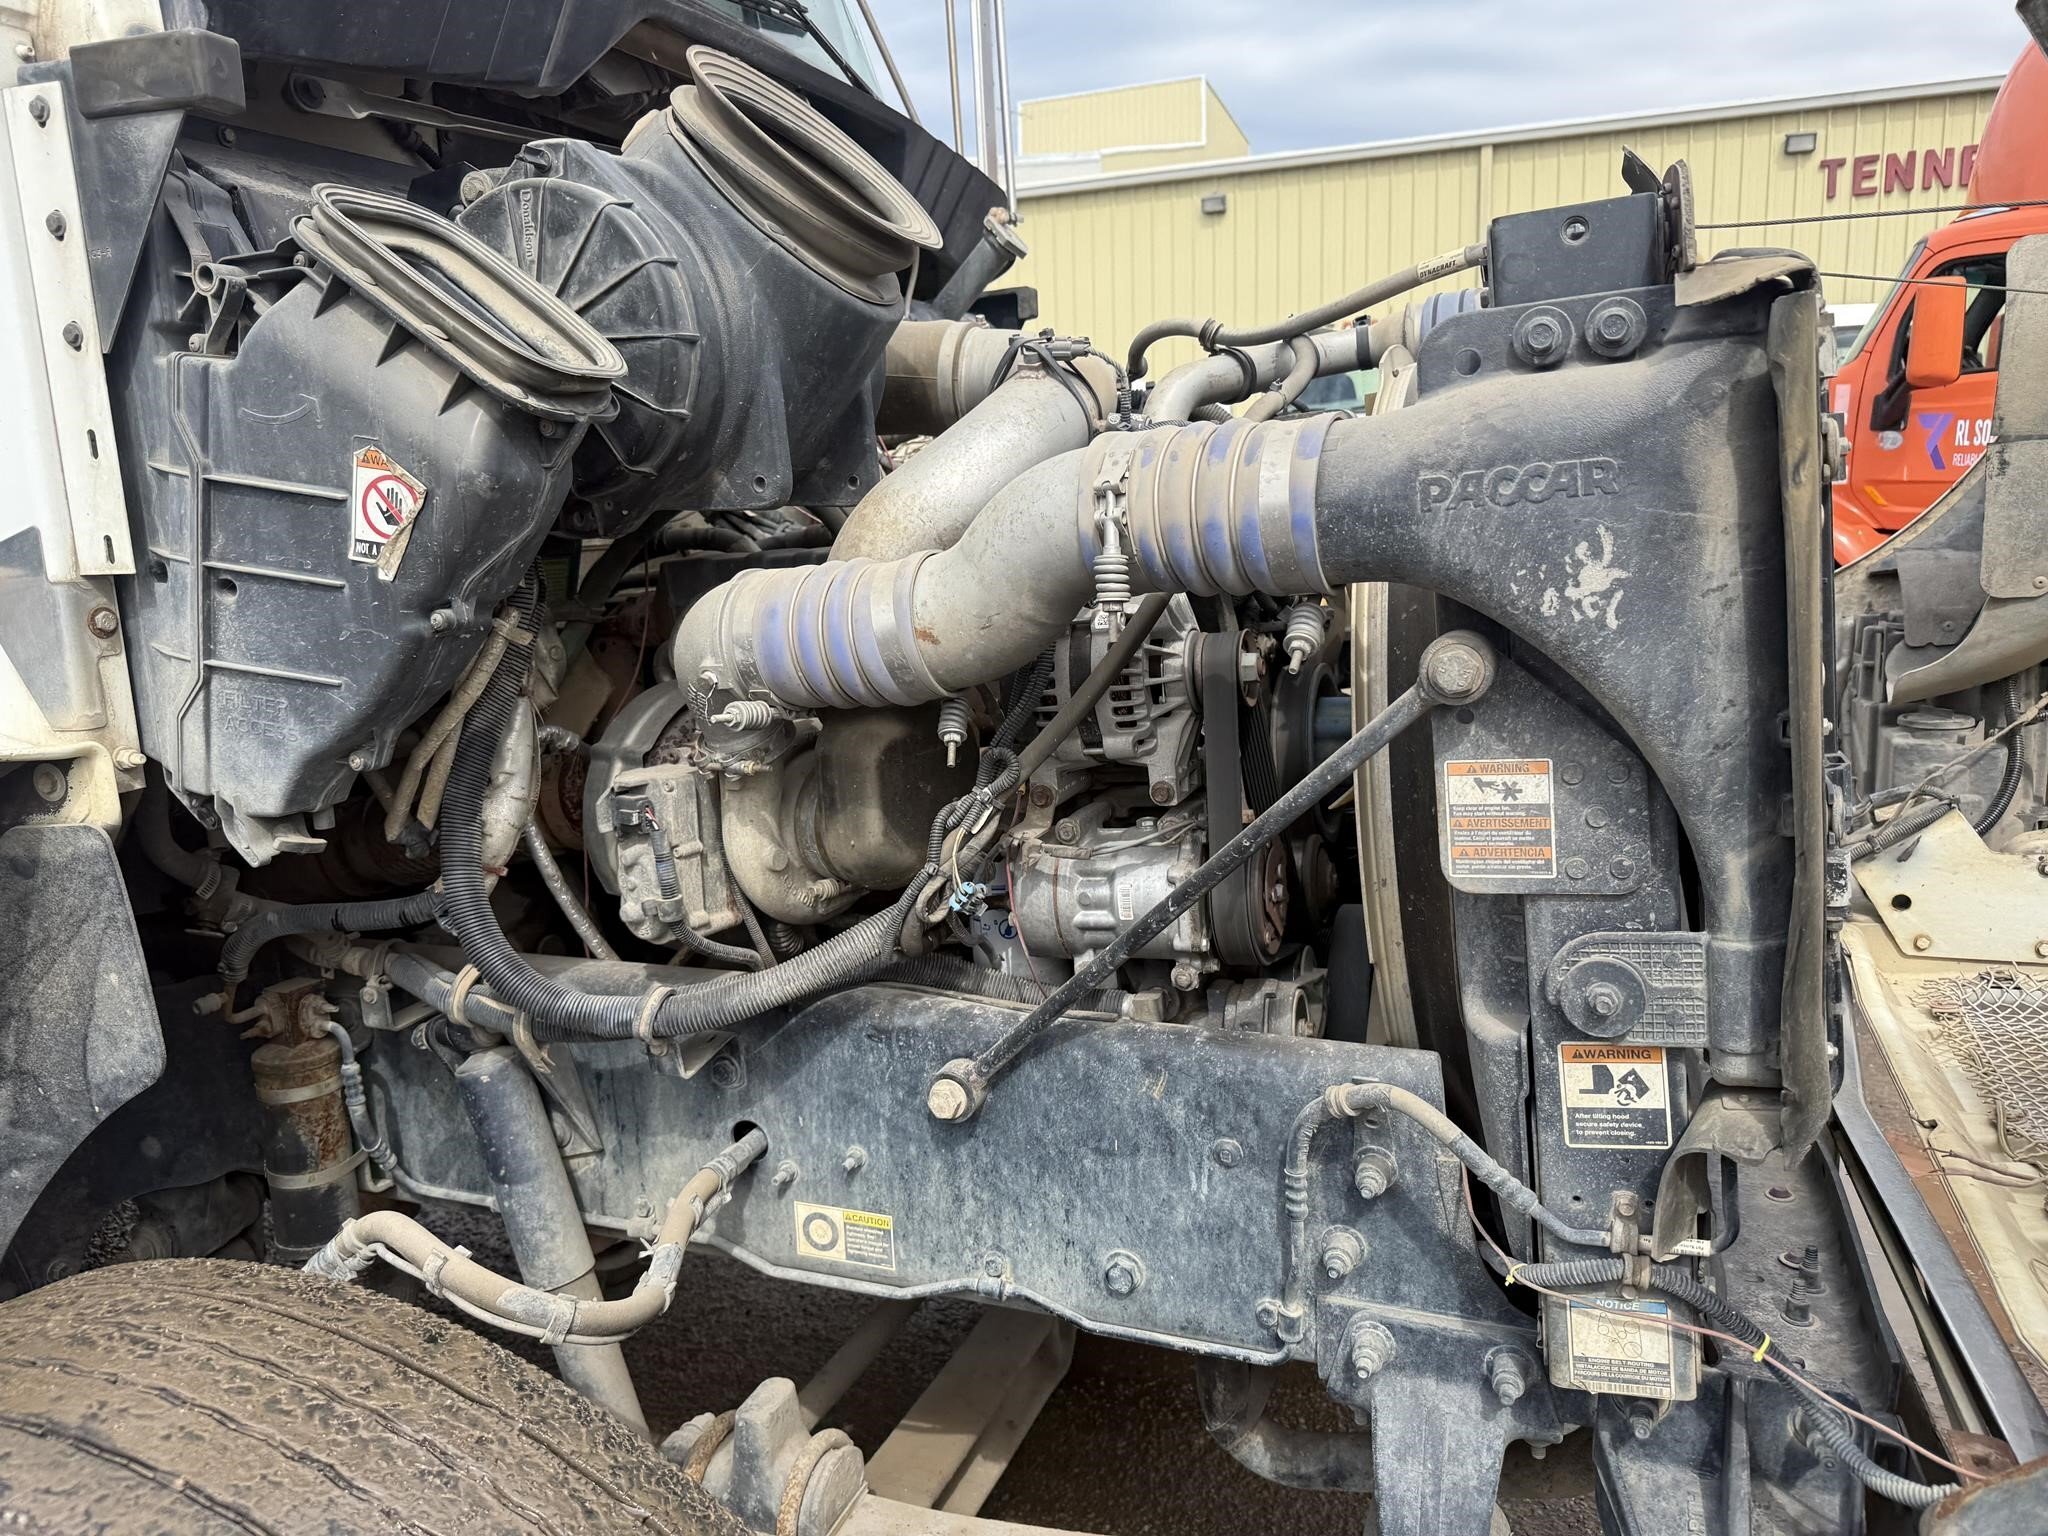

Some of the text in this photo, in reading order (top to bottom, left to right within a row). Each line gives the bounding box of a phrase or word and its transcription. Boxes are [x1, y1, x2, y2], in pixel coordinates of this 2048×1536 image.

[520, 189, 536, 258] Donaldson
[1955, 419, 1998, 446] RL SO
[1416, 457, 1621, 513] PACCAR
[355, 542, 370, 555] NOT
[371, 544, 378, 556] A
[223, 689, 289, 716] FILTER
[224, 715, 298, 742] ACCESS
[1480, 763, 1530, 773] WARNING
[1467, 818, 1548, 828] AVERTISSEMENT
[1473, 848, 1546, 858] ADVERTENCIA
[1583, 1049, 1652, 1060] WARNING
[852, 1214, 889, 1227] CAUTION
[1596, 1300, 1641, 1311] NOTICE
